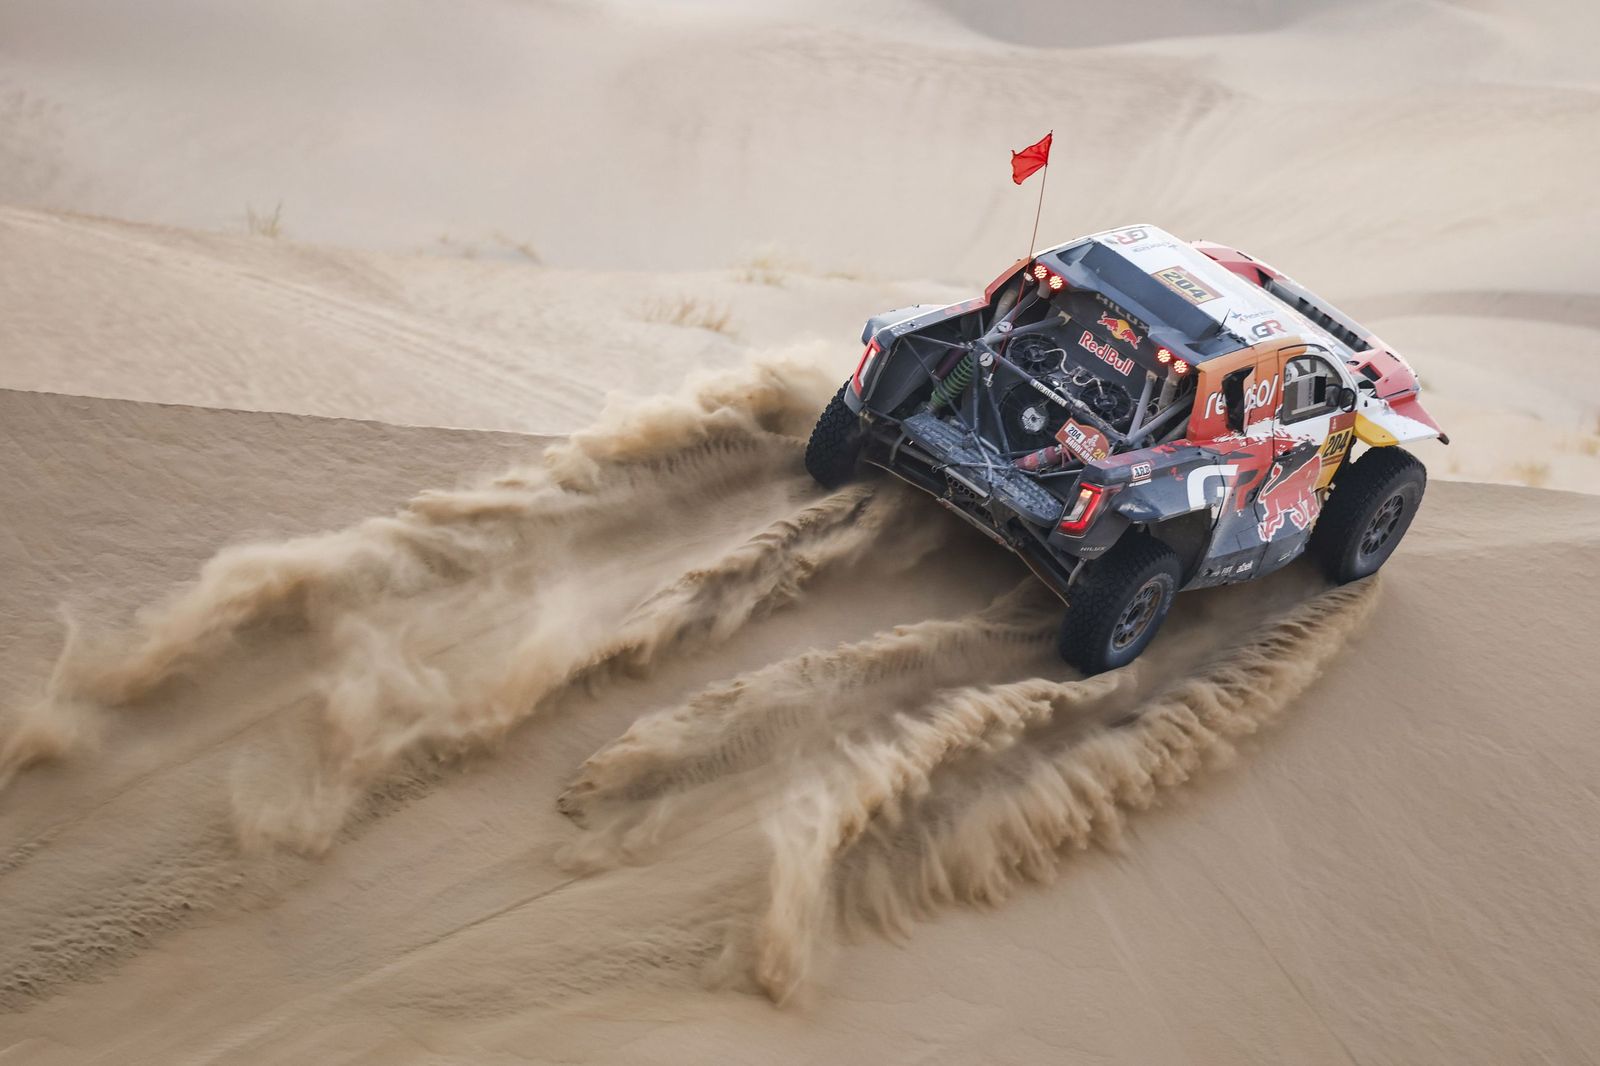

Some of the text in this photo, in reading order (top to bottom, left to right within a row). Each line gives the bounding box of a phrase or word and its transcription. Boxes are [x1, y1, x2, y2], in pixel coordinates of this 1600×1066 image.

[1163, 271, 1207, 298] 204
[1096, 293, 1150, 332] HILUX
[1252, 319, 1287, 338] GR
[1078, 330, 1135, 376] Red Bull
[1068, 427, 1082, 440] 204
[1322, 430, 1350, 458] 204
[1065, 437, 1083, 454] SAUDI
[1134, 465, 1151, 478] ARB
